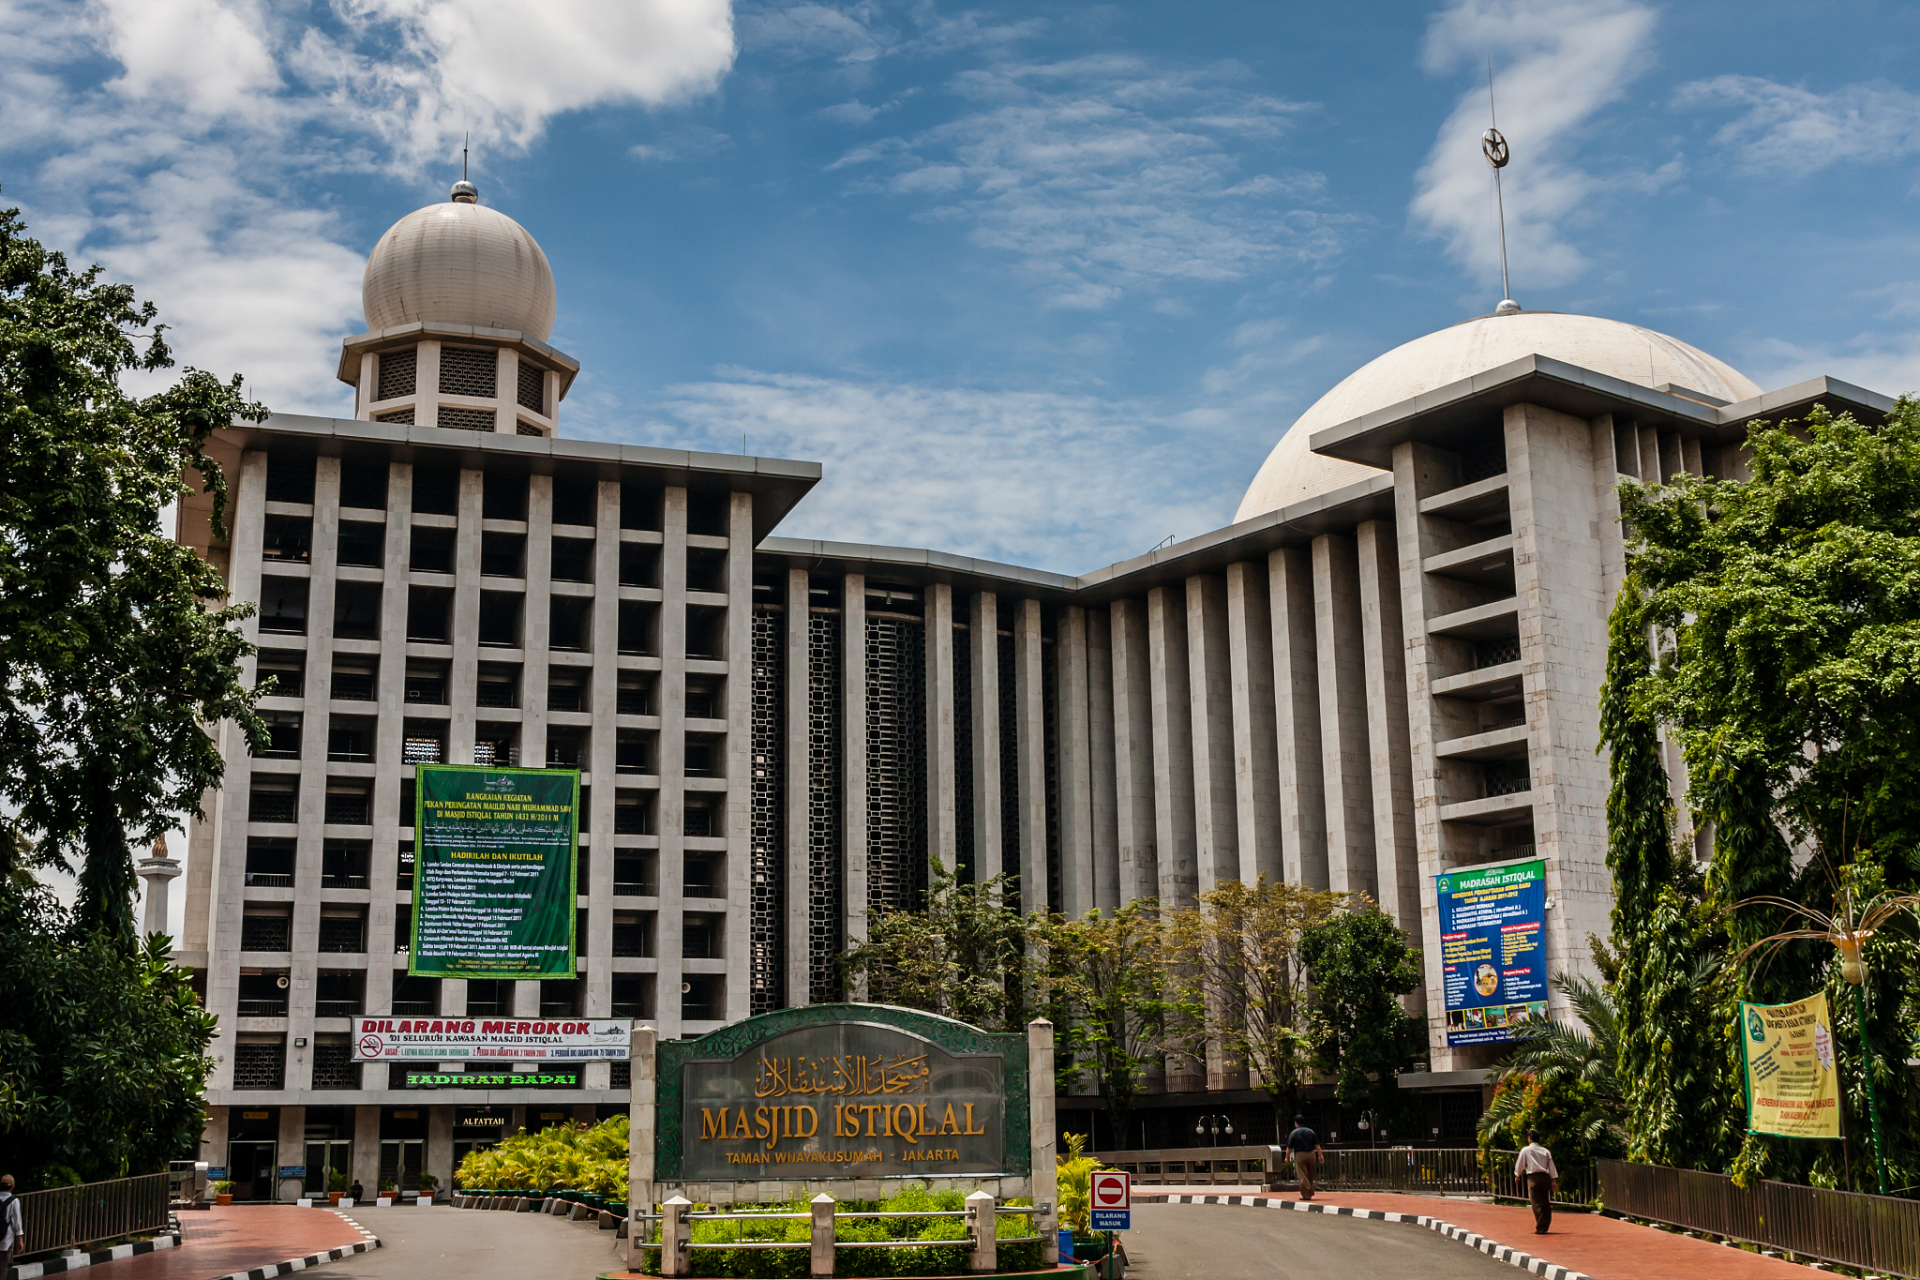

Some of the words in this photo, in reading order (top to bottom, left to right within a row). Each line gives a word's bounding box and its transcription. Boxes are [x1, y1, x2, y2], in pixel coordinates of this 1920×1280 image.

[466, 792, 502, 800] RANGKAIAN
[445, 801, 481, 809] PERINGATAN
[483, 802, 505, 810] MAULID
[522, 804, 559, 812] MUHAMMAD
[444, 811, 465, 820] MASJID
[467, 812, 492, 820] ISTIQLAL
[1460, 877, 1500, 889] MADRASAH
[1502, 870, 1535, 883] ISTIQLAL
[362, 1020, 475, 1033] DILARANG
[482, 1021, 590, 1034] MEROKOK
[700, 1105, 818, 1149] MASJID
[833, 1103, 985, 1144] ISTIQLAL
[726, 1153, 769, 1164] TAMAN
[774, 1150, 882, 1163] WIJAYAKUSUMAH
[902, 1149, 959, 1161] JAKARTA
